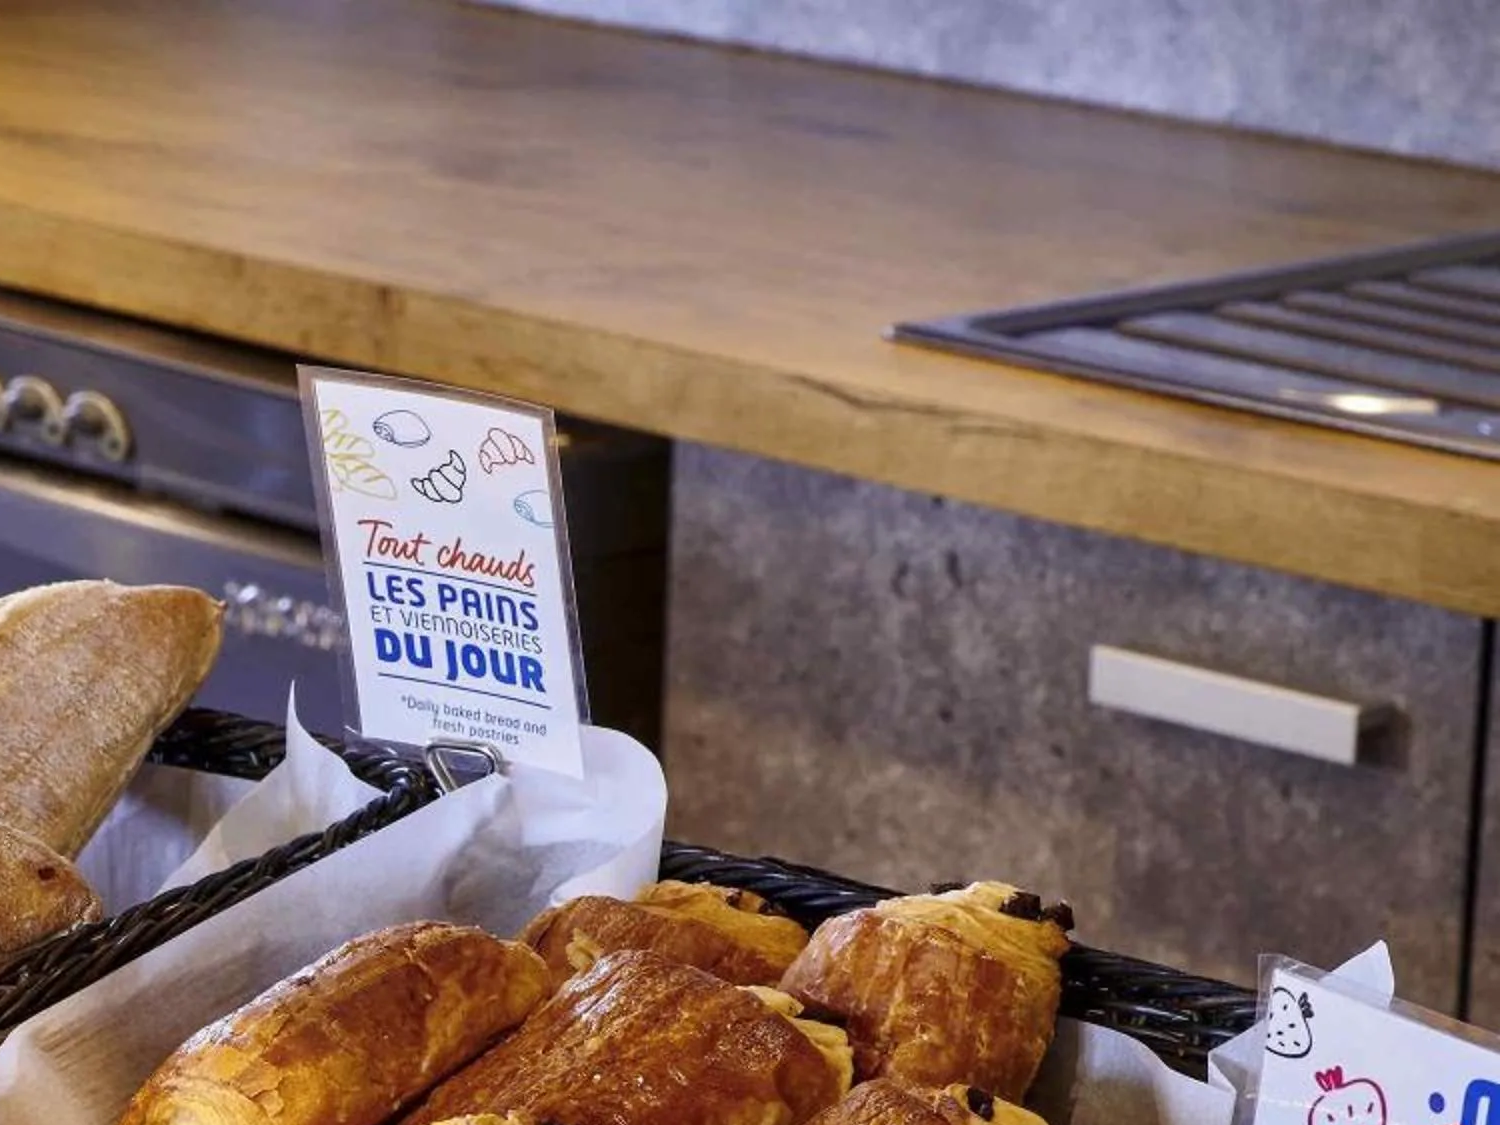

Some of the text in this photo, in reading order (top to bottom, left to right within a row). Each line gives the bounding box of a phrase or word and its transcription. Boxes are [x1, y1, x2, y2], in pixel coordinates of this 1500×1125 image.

[357, 519, 535, 587] Tout chauds
[367, 572, 539, 631] LES PAINS
[371, 605, 543, 654] ET VIENNOISERIES
[374, 628, 547, 693] DU JOUR
[432, 718, 520, 746] fresh pastries
[443, 704, 481, 722] baked
[485, 711, 521, 730] bread
[523, 719, 547, 737] and
